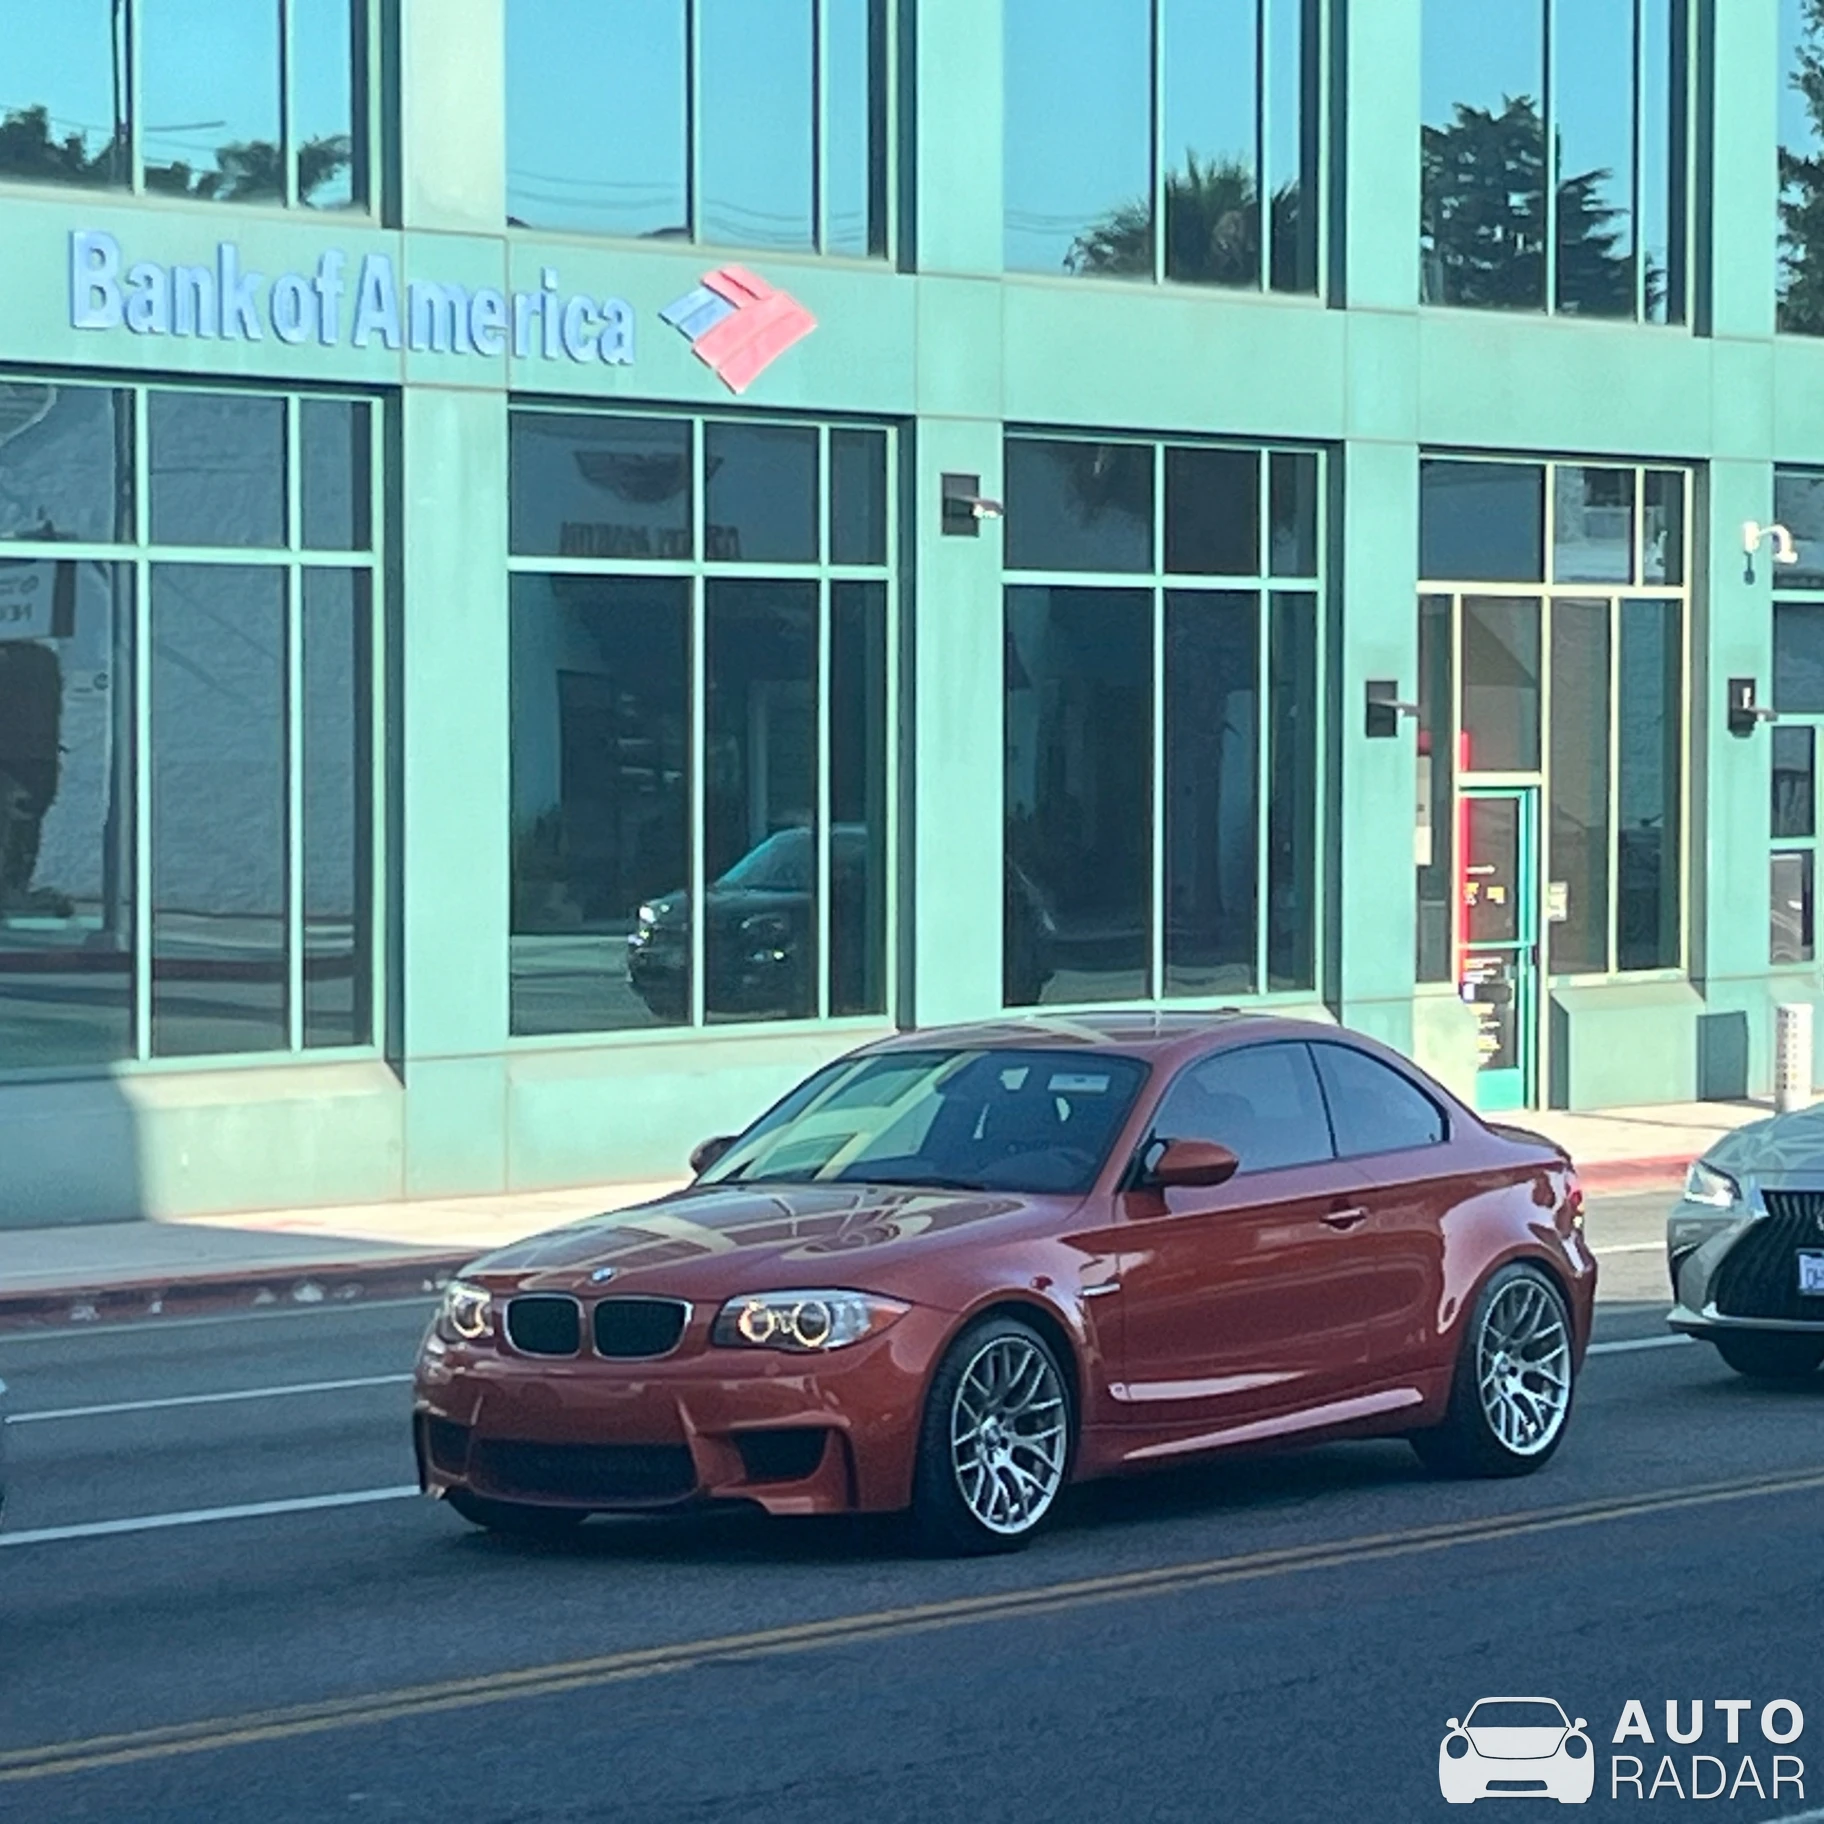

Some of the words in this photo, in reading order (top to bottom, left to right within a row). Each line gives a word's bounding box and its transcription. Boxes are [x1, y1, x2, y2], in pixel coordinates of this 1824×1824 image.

[69, 230, 265, 341] Bank
[270, 249, 345, 346] of
[351, 253, 635, 366] America
